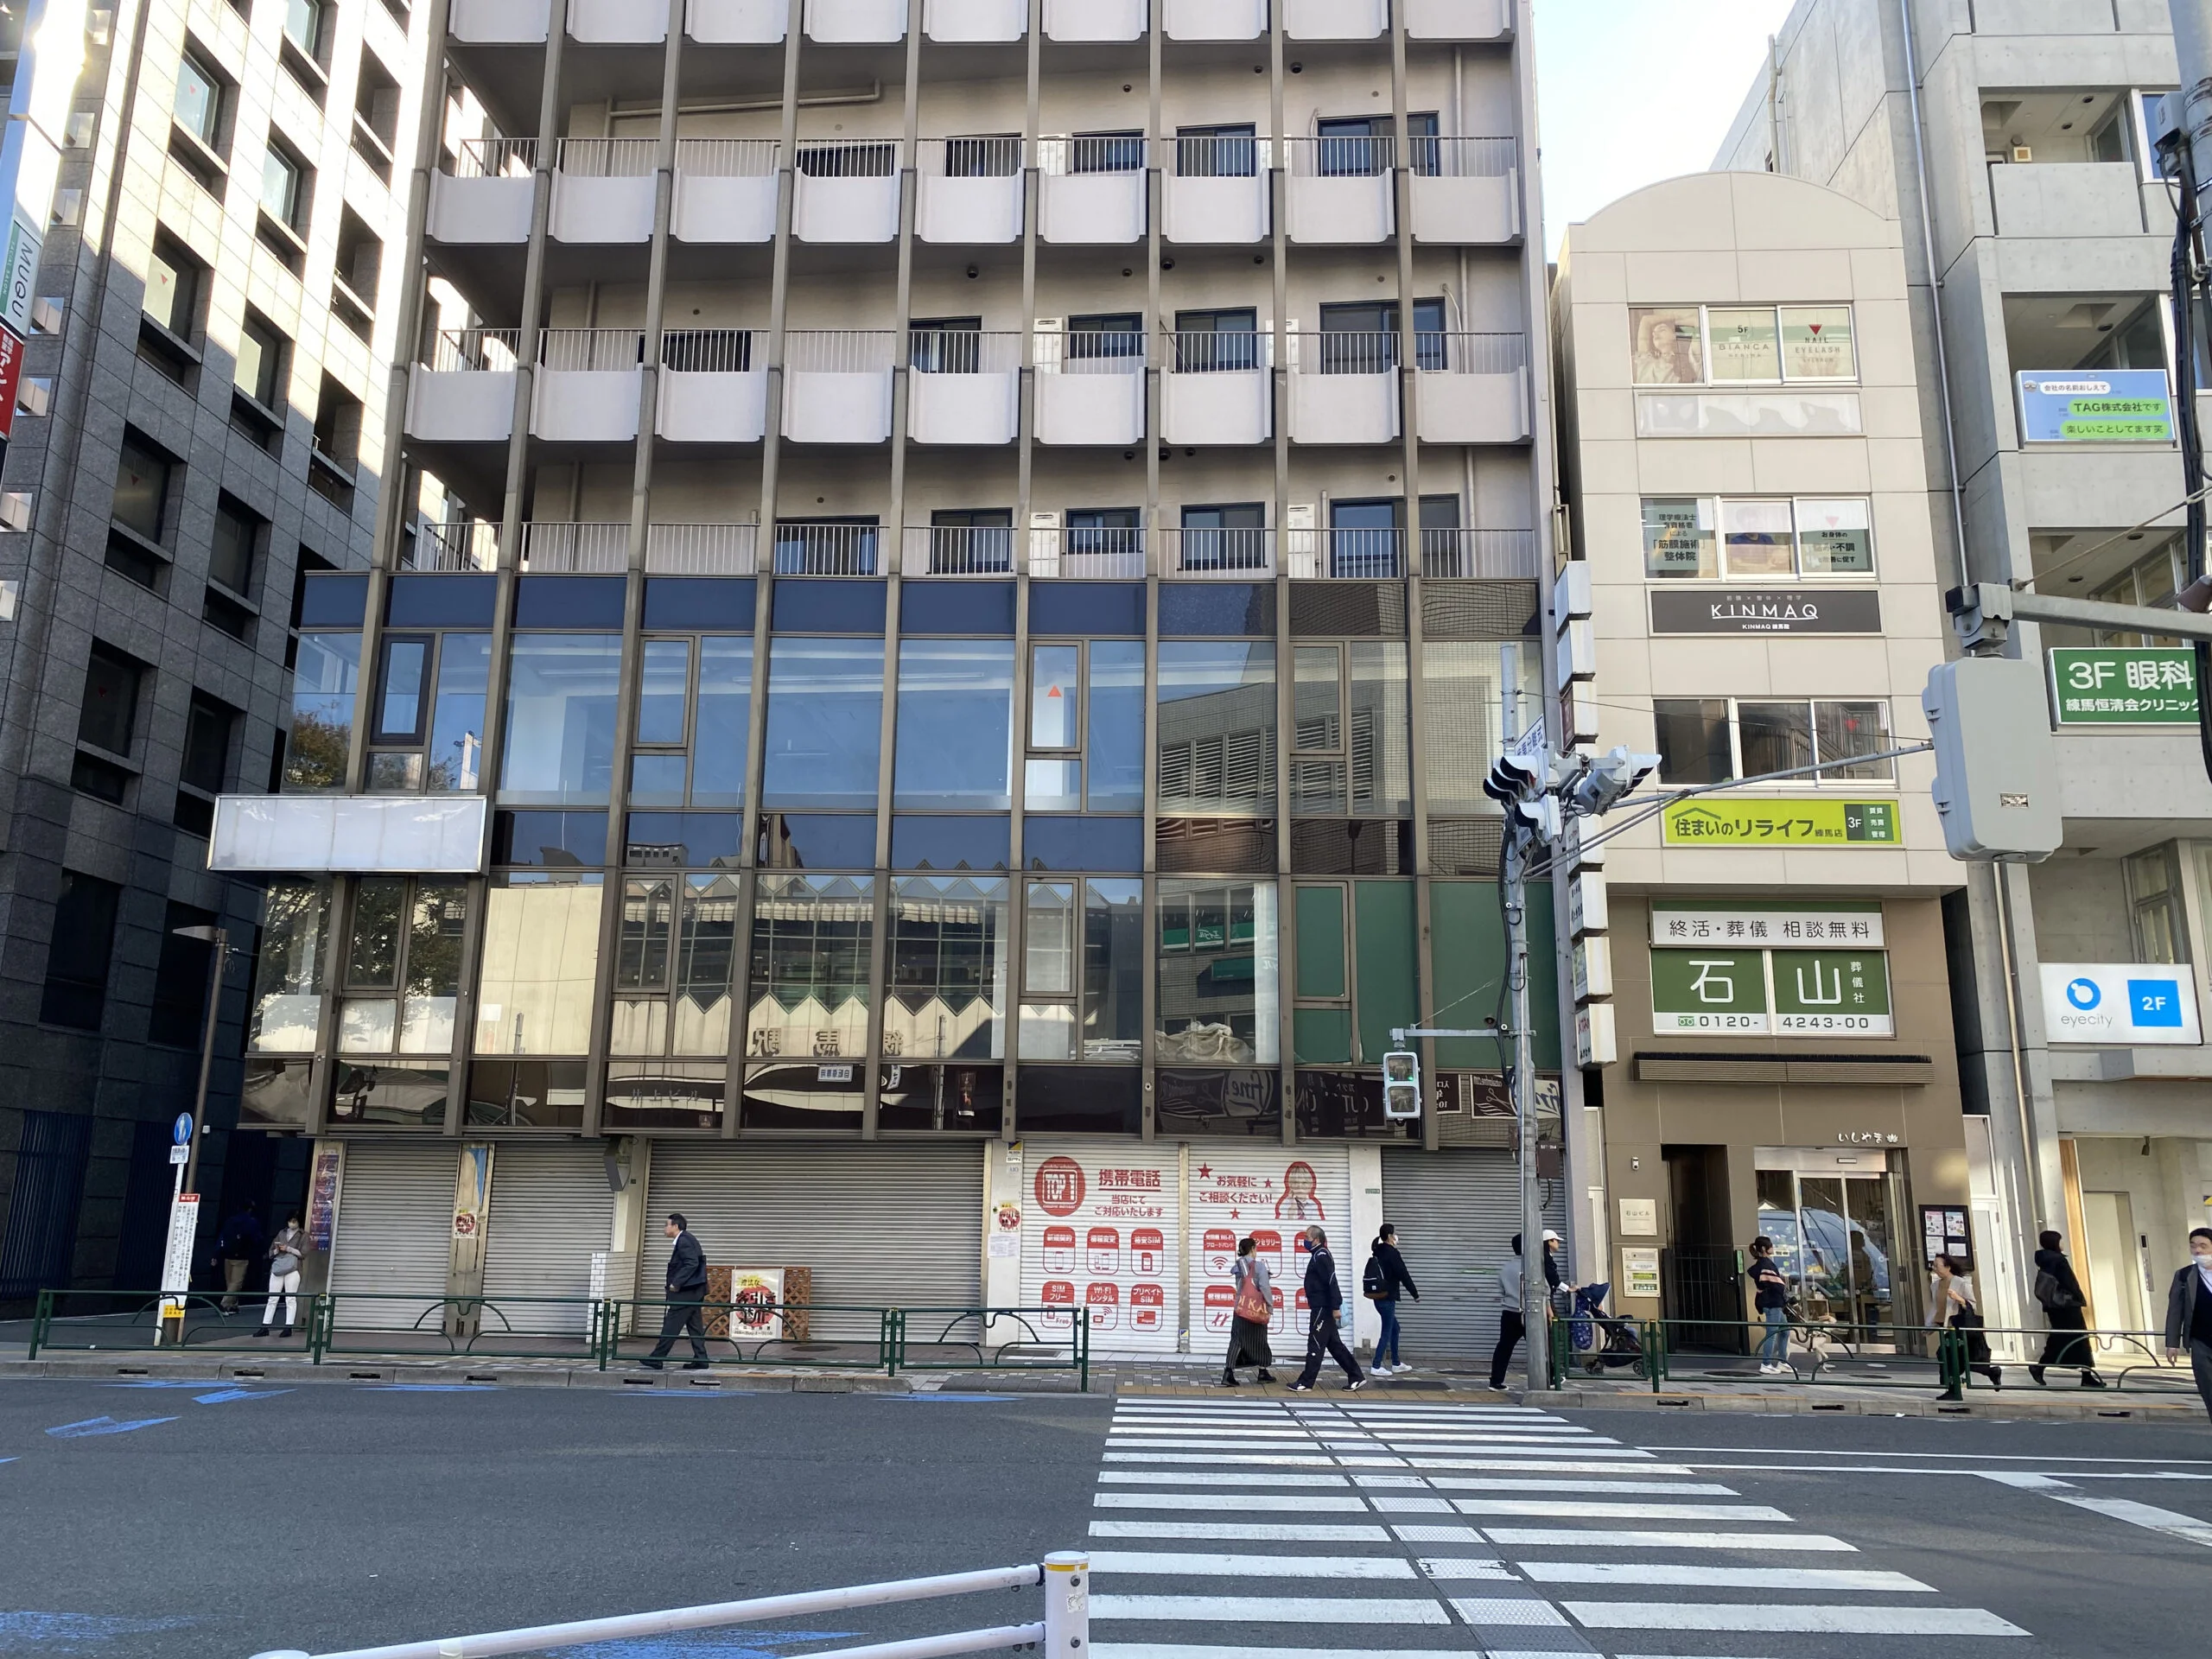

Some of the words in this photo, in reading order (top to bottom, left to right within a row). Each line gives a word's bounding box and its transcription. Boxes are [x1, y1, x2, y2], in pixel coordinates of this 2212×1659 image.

[11, 242, 33, 319] MUQU
[1738, 325, 1749, 334] 5F
[2074, 402, 2161, 412] TAG株式会社です
[2067, 424, 2164, 434] 楽しいことしてます笑
[1664, 551, 1697, 562] 整体院
[1711, 604, 1818, 620] KINMAQ
[2069, 661, 2116, 690] 3F
[2126, 660, 2195, 690] 眼科
[1675, 818, 1814, 837] 住まいのリライフ
[1815, 829, 1843, 837] 練馬店
[1847, 817, 1862, 828] 3F
[1669, 919, 1768, 938] 終活・葬儀
[1783, 921, 1870, 939] 相談無料
[1850, 961, 1866, 1004] 葬儀社
[2142, 996, 2166, 1011] 2F
[2061, 1014, 2113, 1028] eyecity
[1838, 1132, 1884, 1144] いしやま
[1098, 1169, 1160, 1187] 携帯電話
[1217, 1176, 1257, 1188] お気軽に
[1111, 1194, 1147, 1205] 当店にて
[1095, 1206, 1163, 1217] ご対応いたします
